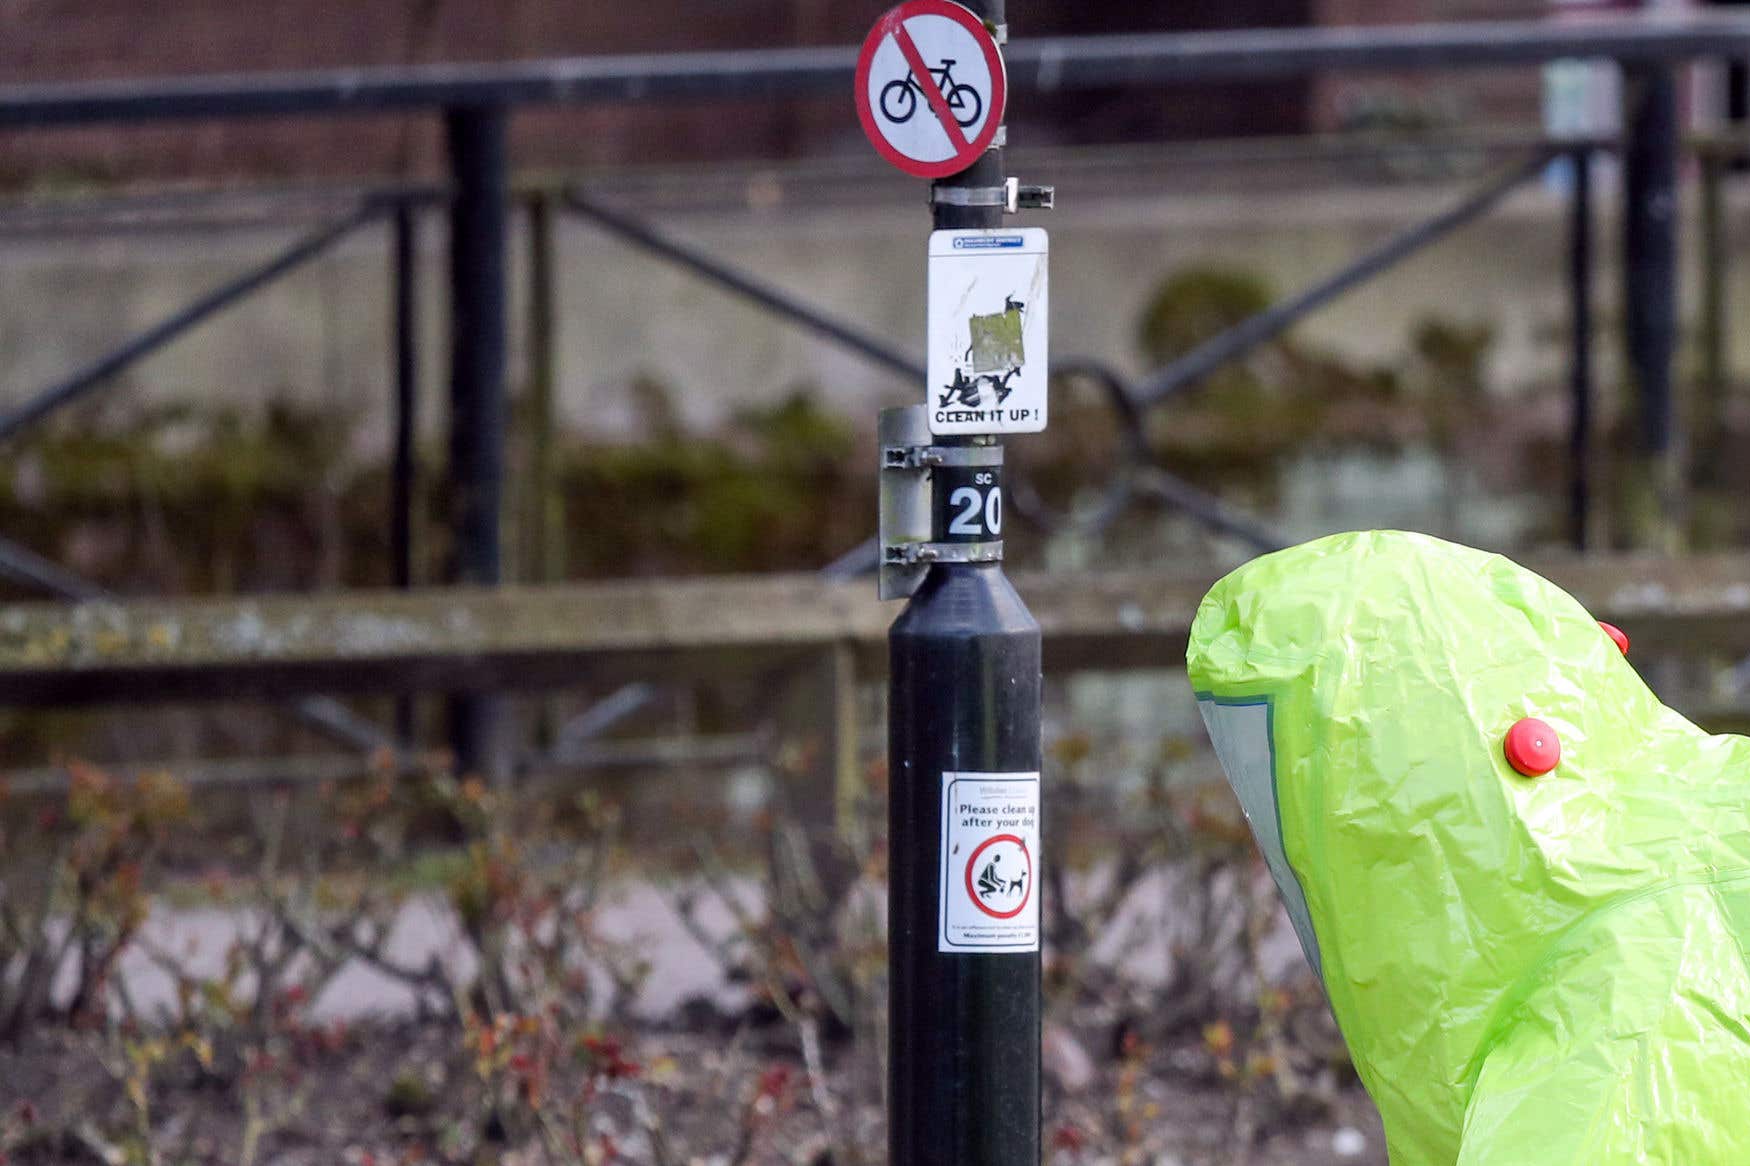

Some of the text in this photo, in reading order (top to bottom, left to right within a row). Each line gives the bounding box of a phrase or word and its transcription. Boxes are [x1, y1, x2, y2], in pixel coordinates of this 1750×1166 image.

[935, 411, 985, 423] CLEAN
[990, 410, 1004, 422] IT
[1010, 409, 1029, 421] UP
[949, 486, 1001, 535] 20
[960, 804, 999, 814] Please
[1002, 804, 1026, 814] clean
[962, 817, 993, 827] after
[997, 819, 1020, 830] your
